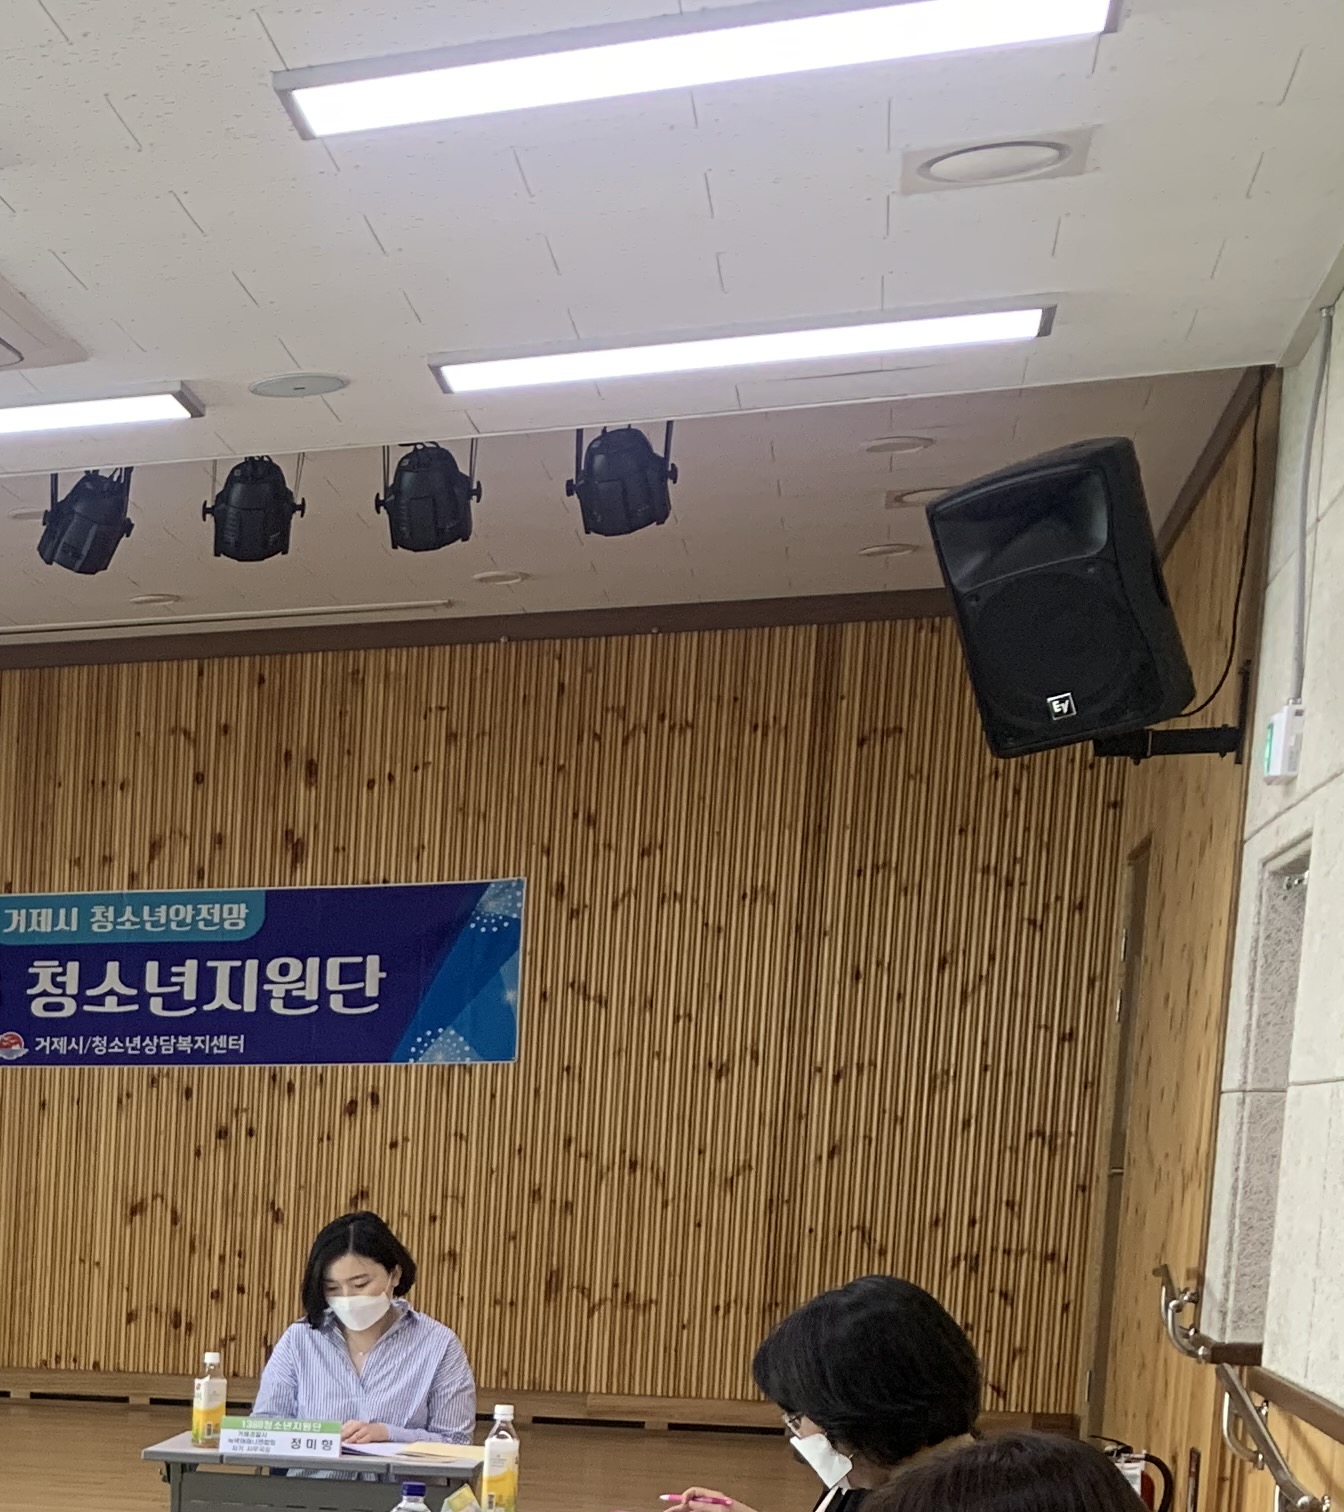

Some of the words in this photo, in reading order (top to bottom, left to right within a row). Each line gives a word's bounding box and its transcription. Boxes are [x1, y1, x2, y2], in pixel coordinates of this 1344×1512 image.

[3, 907, 78, 933] 거제시
[90, 903, 249, 932] 청소년안전망
[26, 954, 388, 1017] 청소년지원단
[35, 1035, 245, 1055] 거제시/청소년상담복지센터
